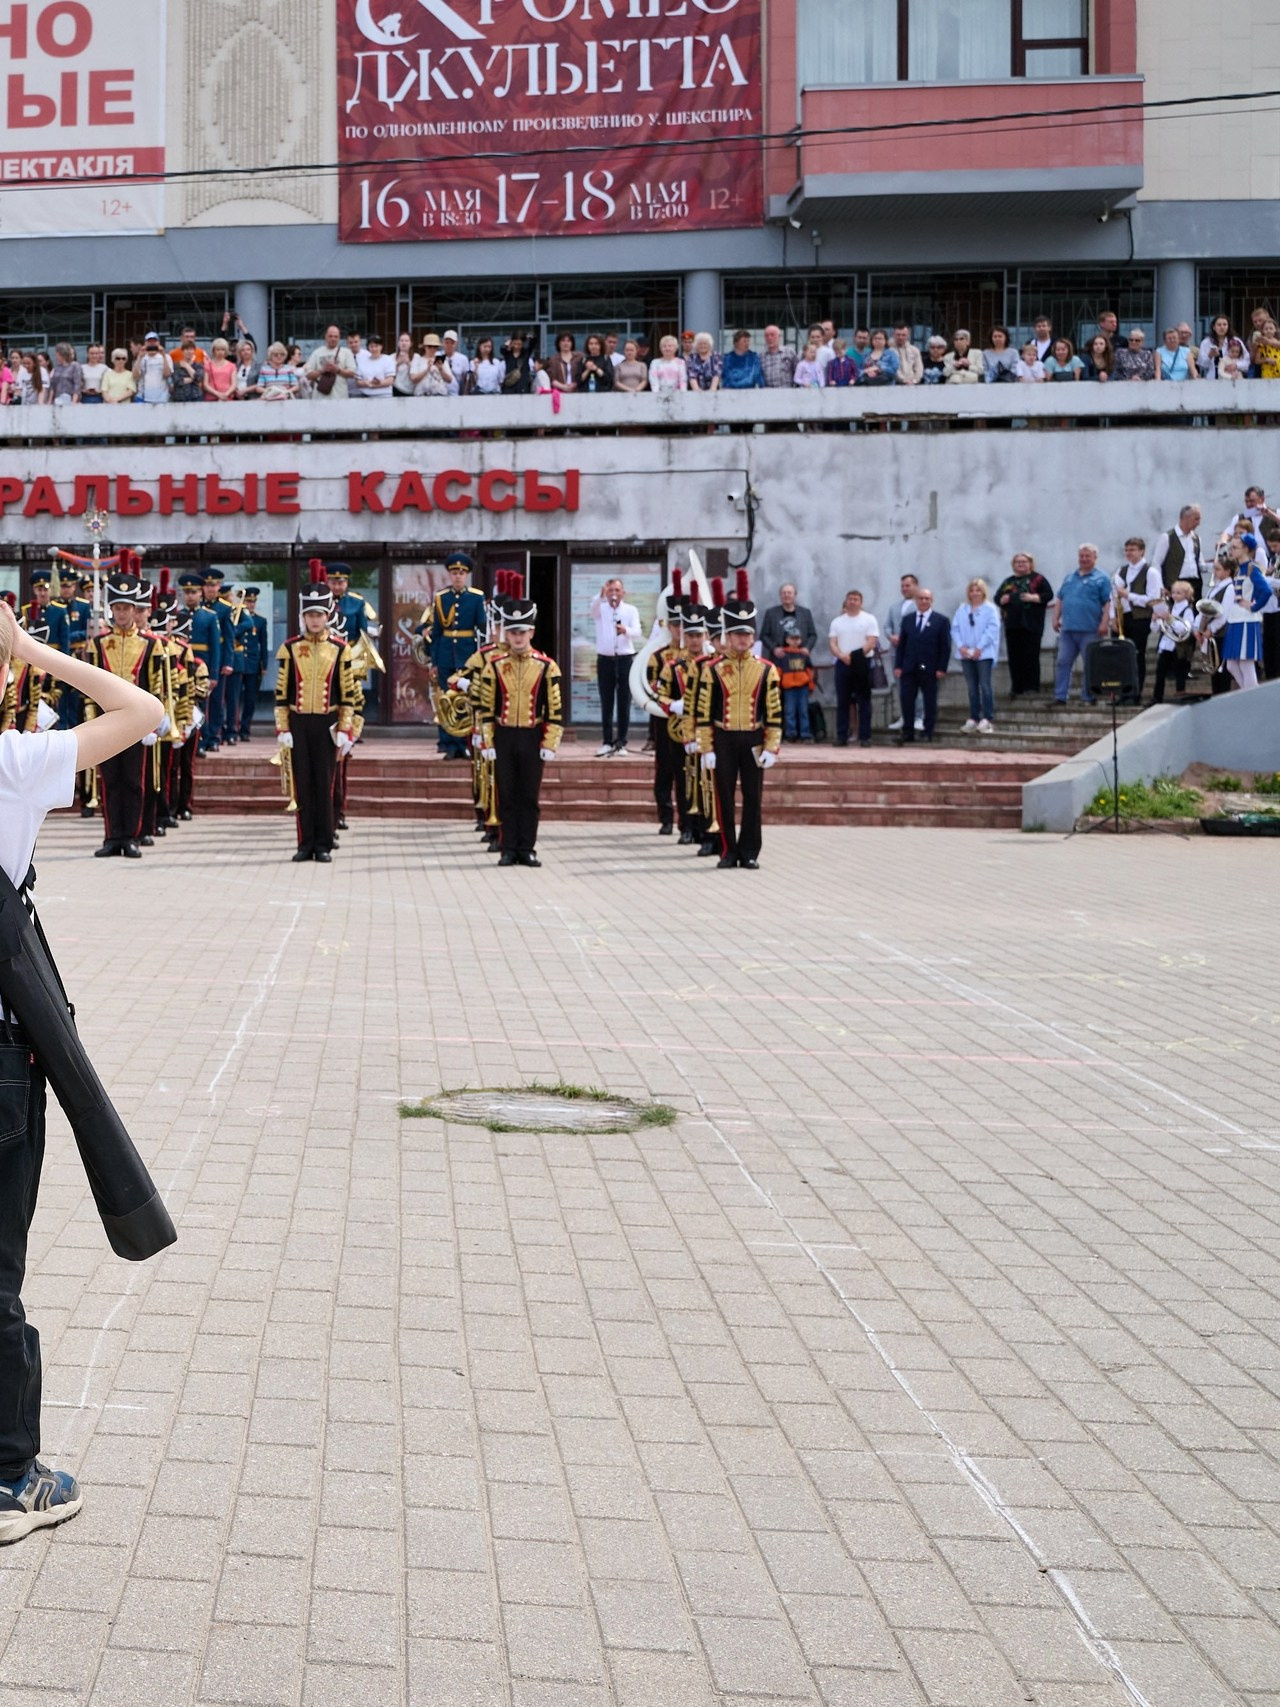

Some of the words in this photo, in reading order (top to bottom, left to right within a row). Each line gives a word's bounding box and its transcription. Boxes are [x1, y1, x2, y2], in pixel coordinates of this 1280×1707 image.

[346, 33, 749, 113] ДЖУЛЬЕТТА
[345, 125, 368, 139] ПО
[373, 119, 507, 138] ОДНОИМЕННОМУ
[513, 114, 643, 131] ПРОИЗВЕДЕНИЮ
[666, 108, 753, 125] ШЕКСПИРА
[359, 179, 410, 228] 16
[424, 189, 480, 211] МАЯ
[630, 180, 687, 204] МАЯ
[709, 188, 743, 210] 12+
[101, 199, 133, 216] 12+
[423, 212, 435, 227] В
[441, 211, 481, 226] 18:30
[630, 205, 642, 220] В
[648, 203, 689, 219] 17:00
[348, 469, 580, 514] КАССЫ
